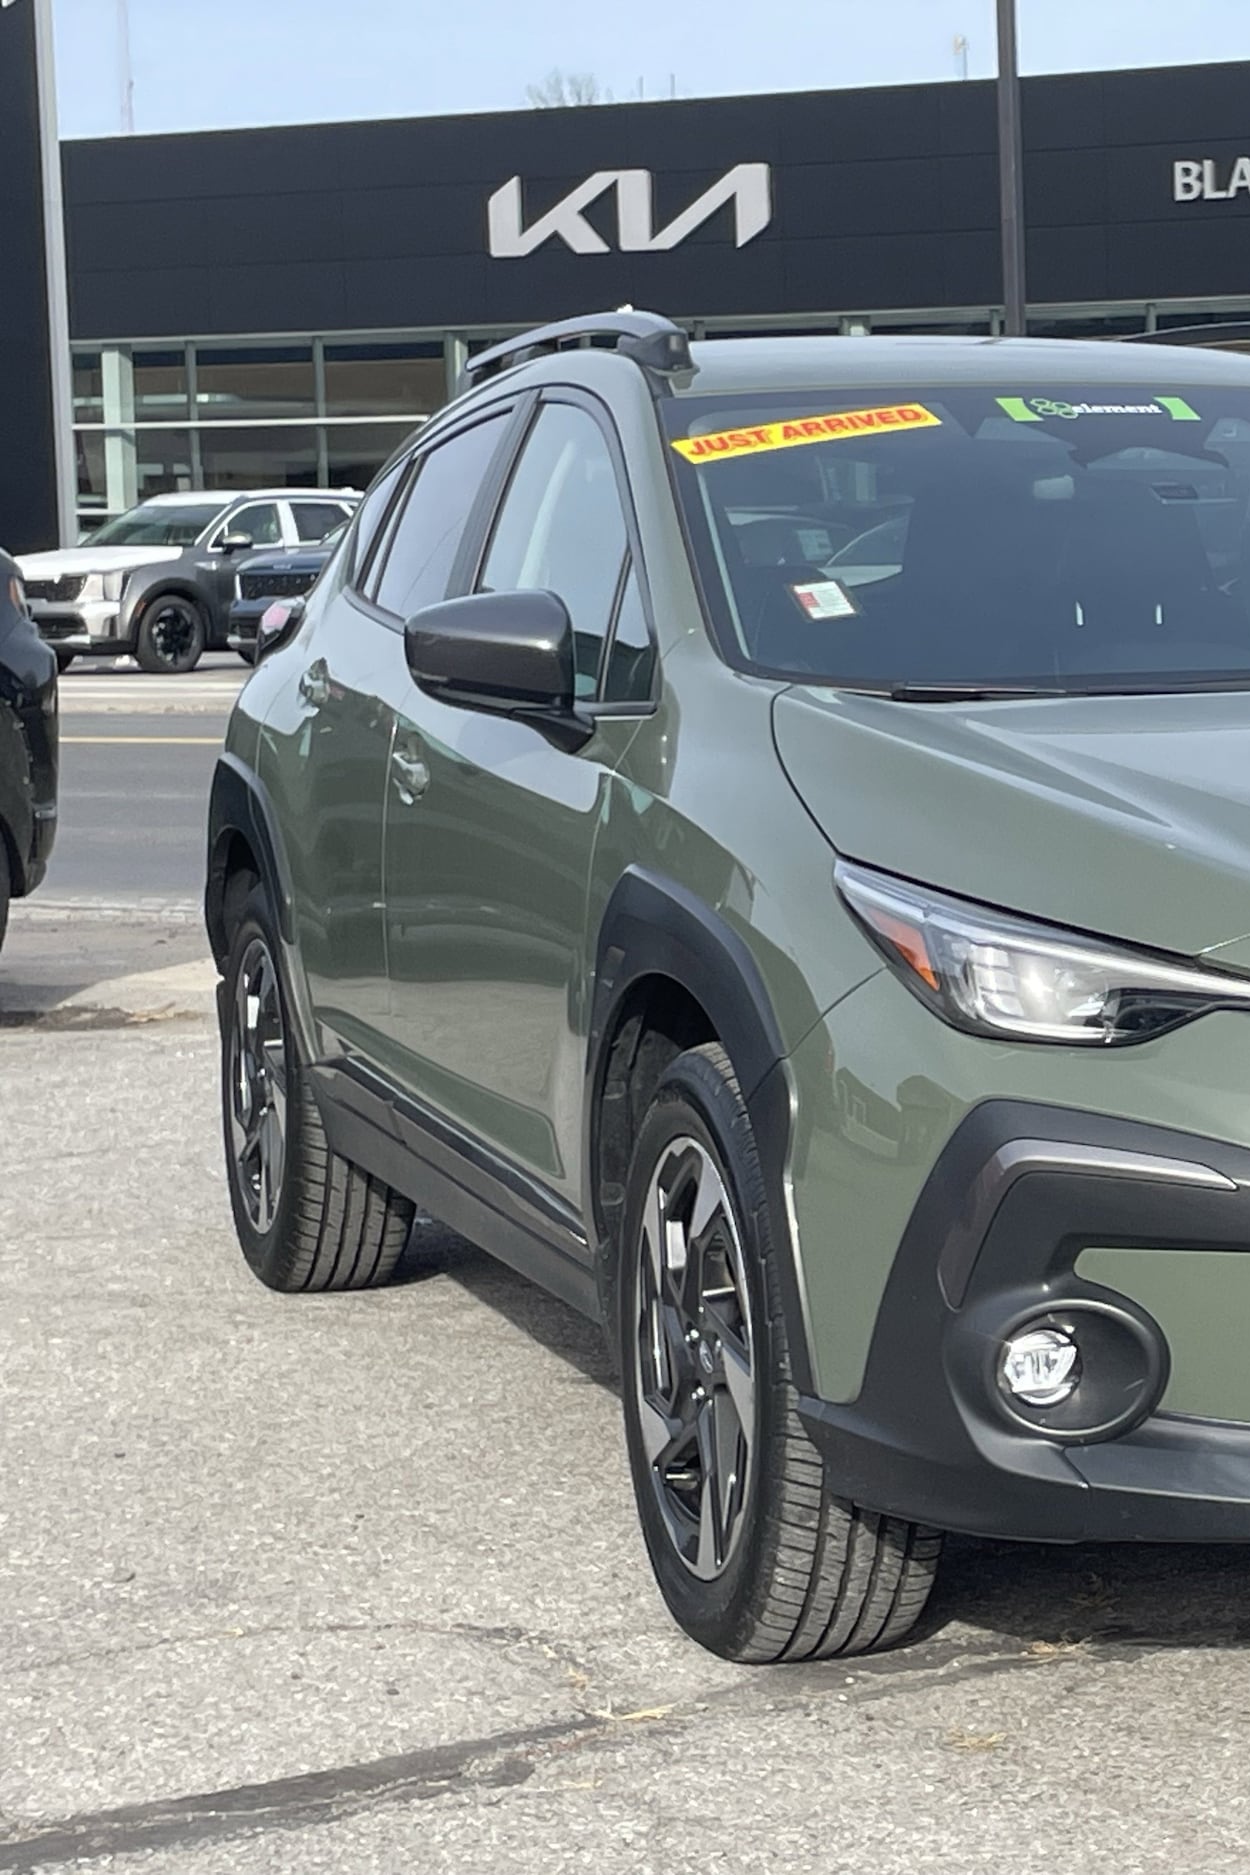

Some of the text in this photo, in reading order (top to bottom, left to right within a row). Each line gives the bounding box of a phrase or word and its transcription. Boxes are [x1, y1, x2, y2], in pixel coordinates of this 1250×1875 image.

[487, 161, 772, 259] KIA
[689, 407, 927, 456] JUST ARRIVED
[1071, 403, 1163, 414] element
